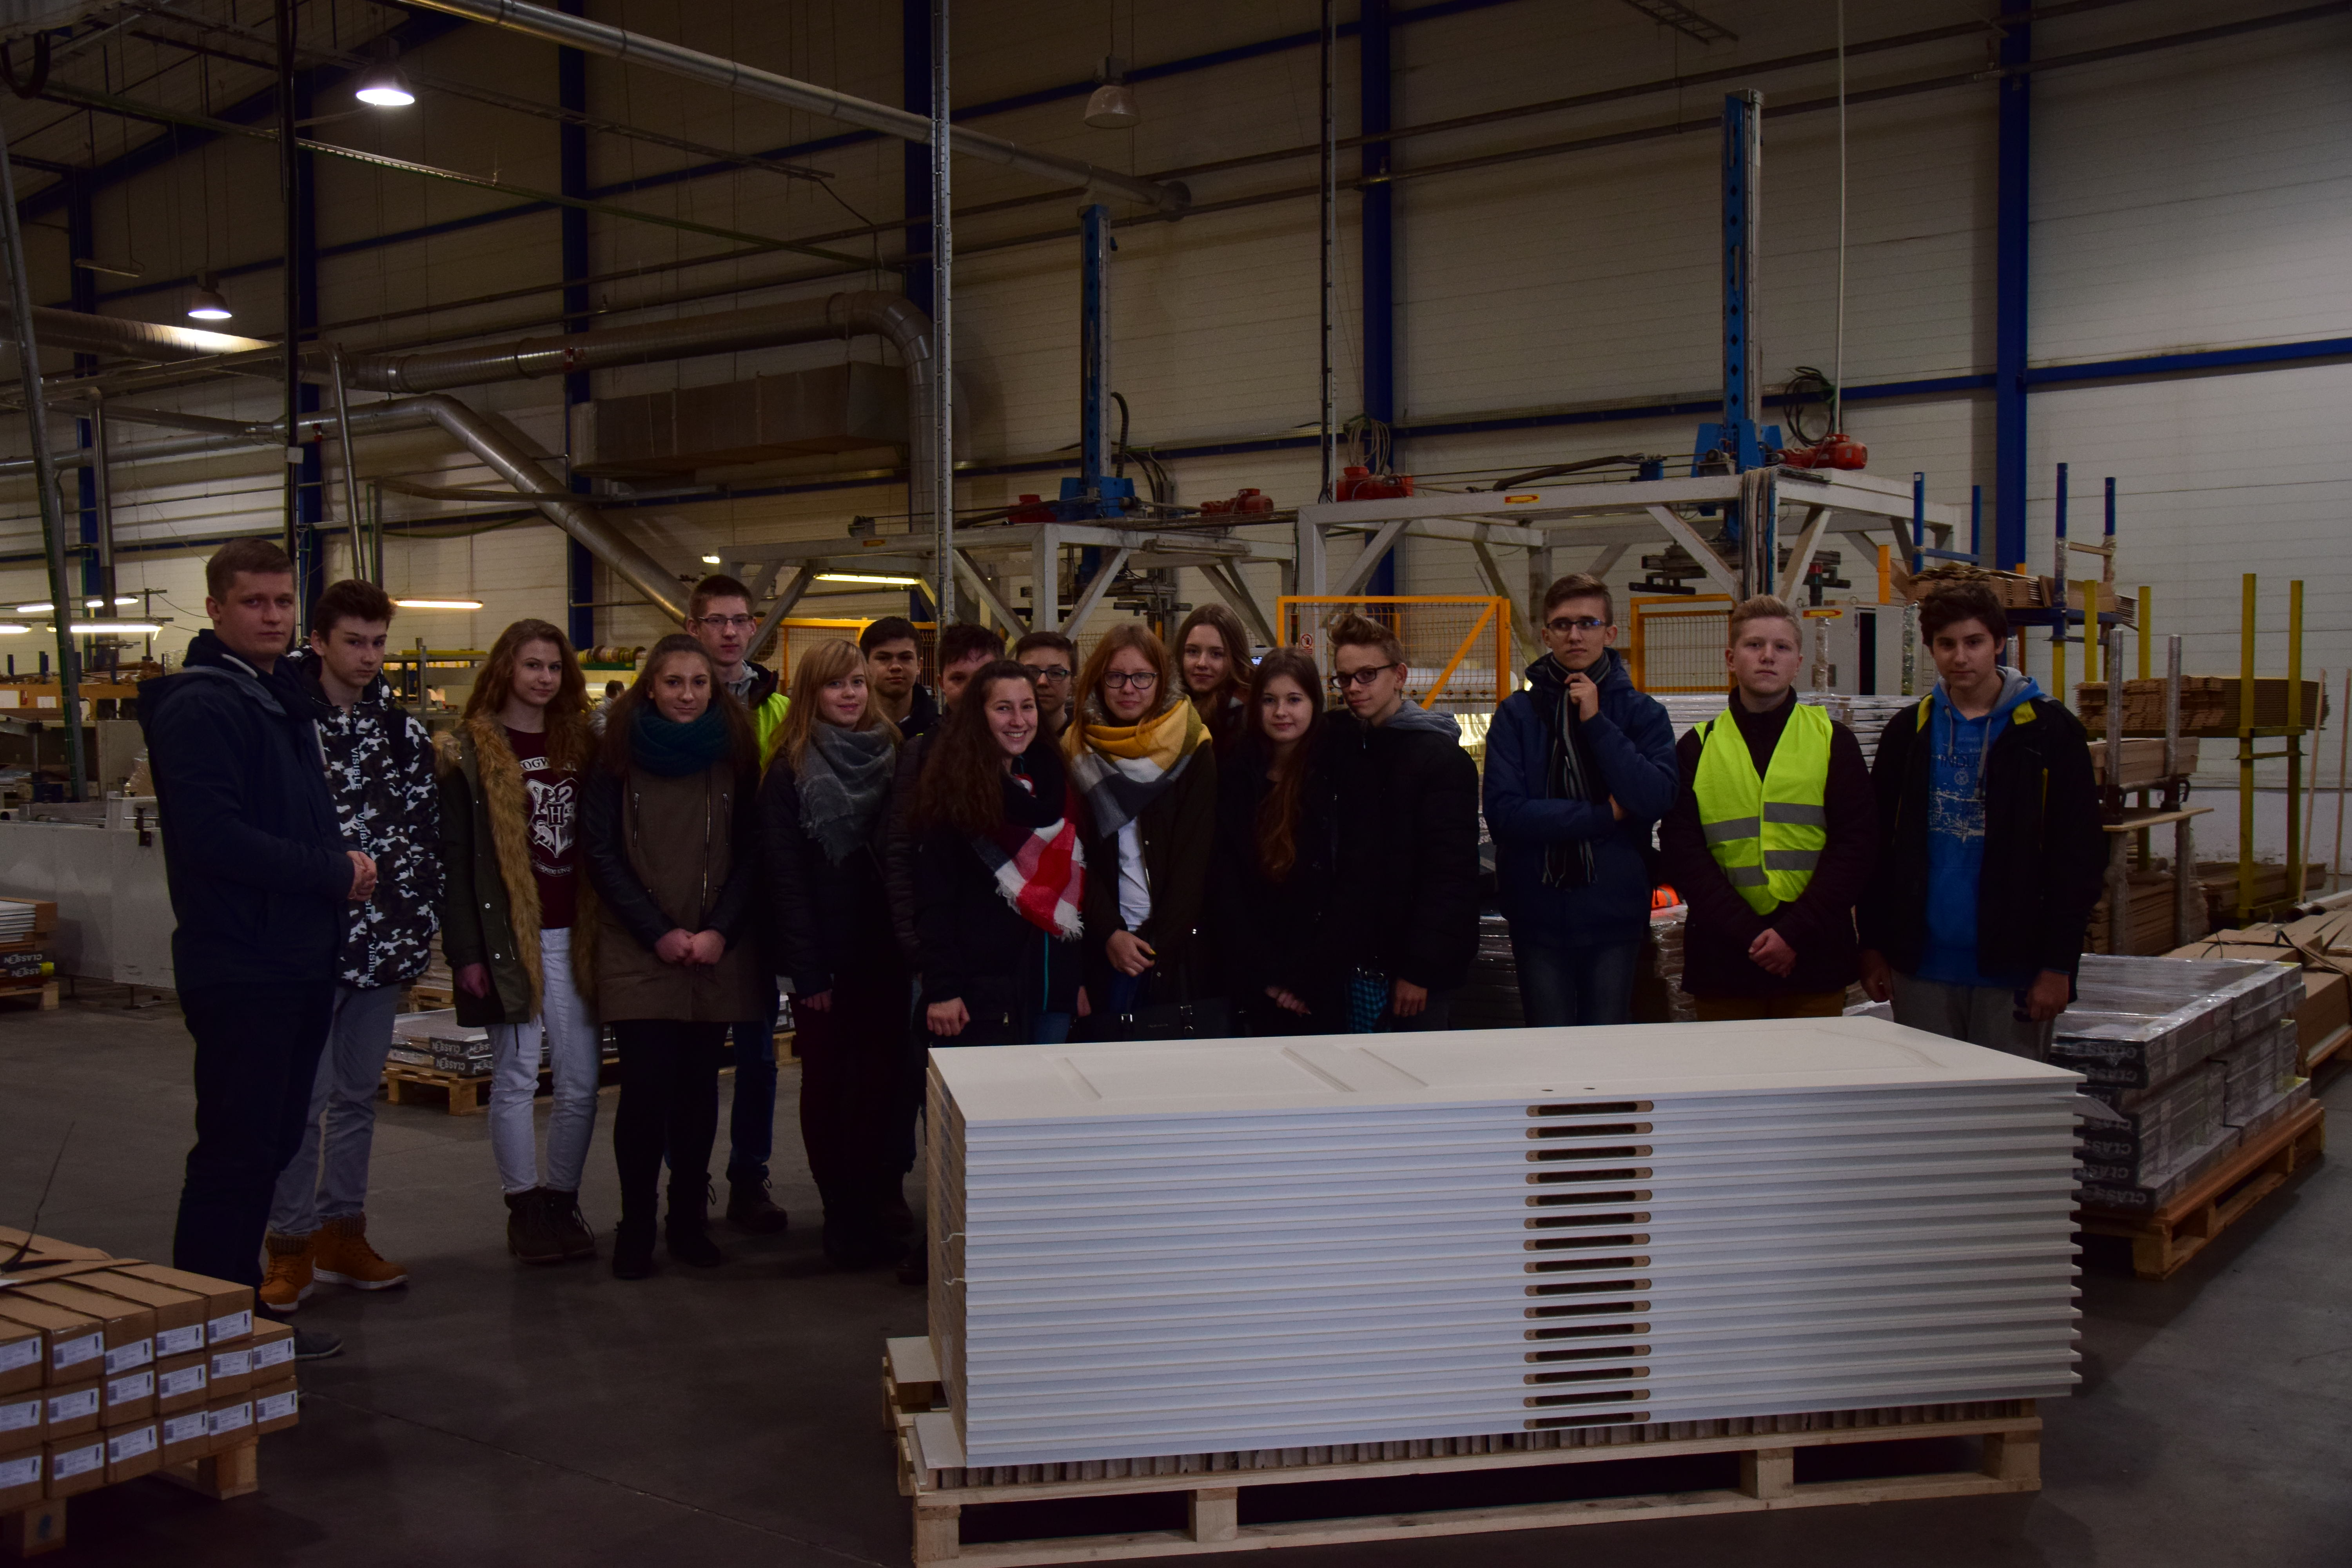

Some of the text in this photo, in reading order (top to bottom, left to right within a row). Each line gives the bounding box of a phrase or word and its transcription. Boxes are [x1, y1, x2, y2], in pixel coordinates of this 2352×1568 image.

[351, 747, 362, 790] VISIBLE
[11, 967, 41, 977] ASSEN
[367, 943, 376, 986] VISIBLE
